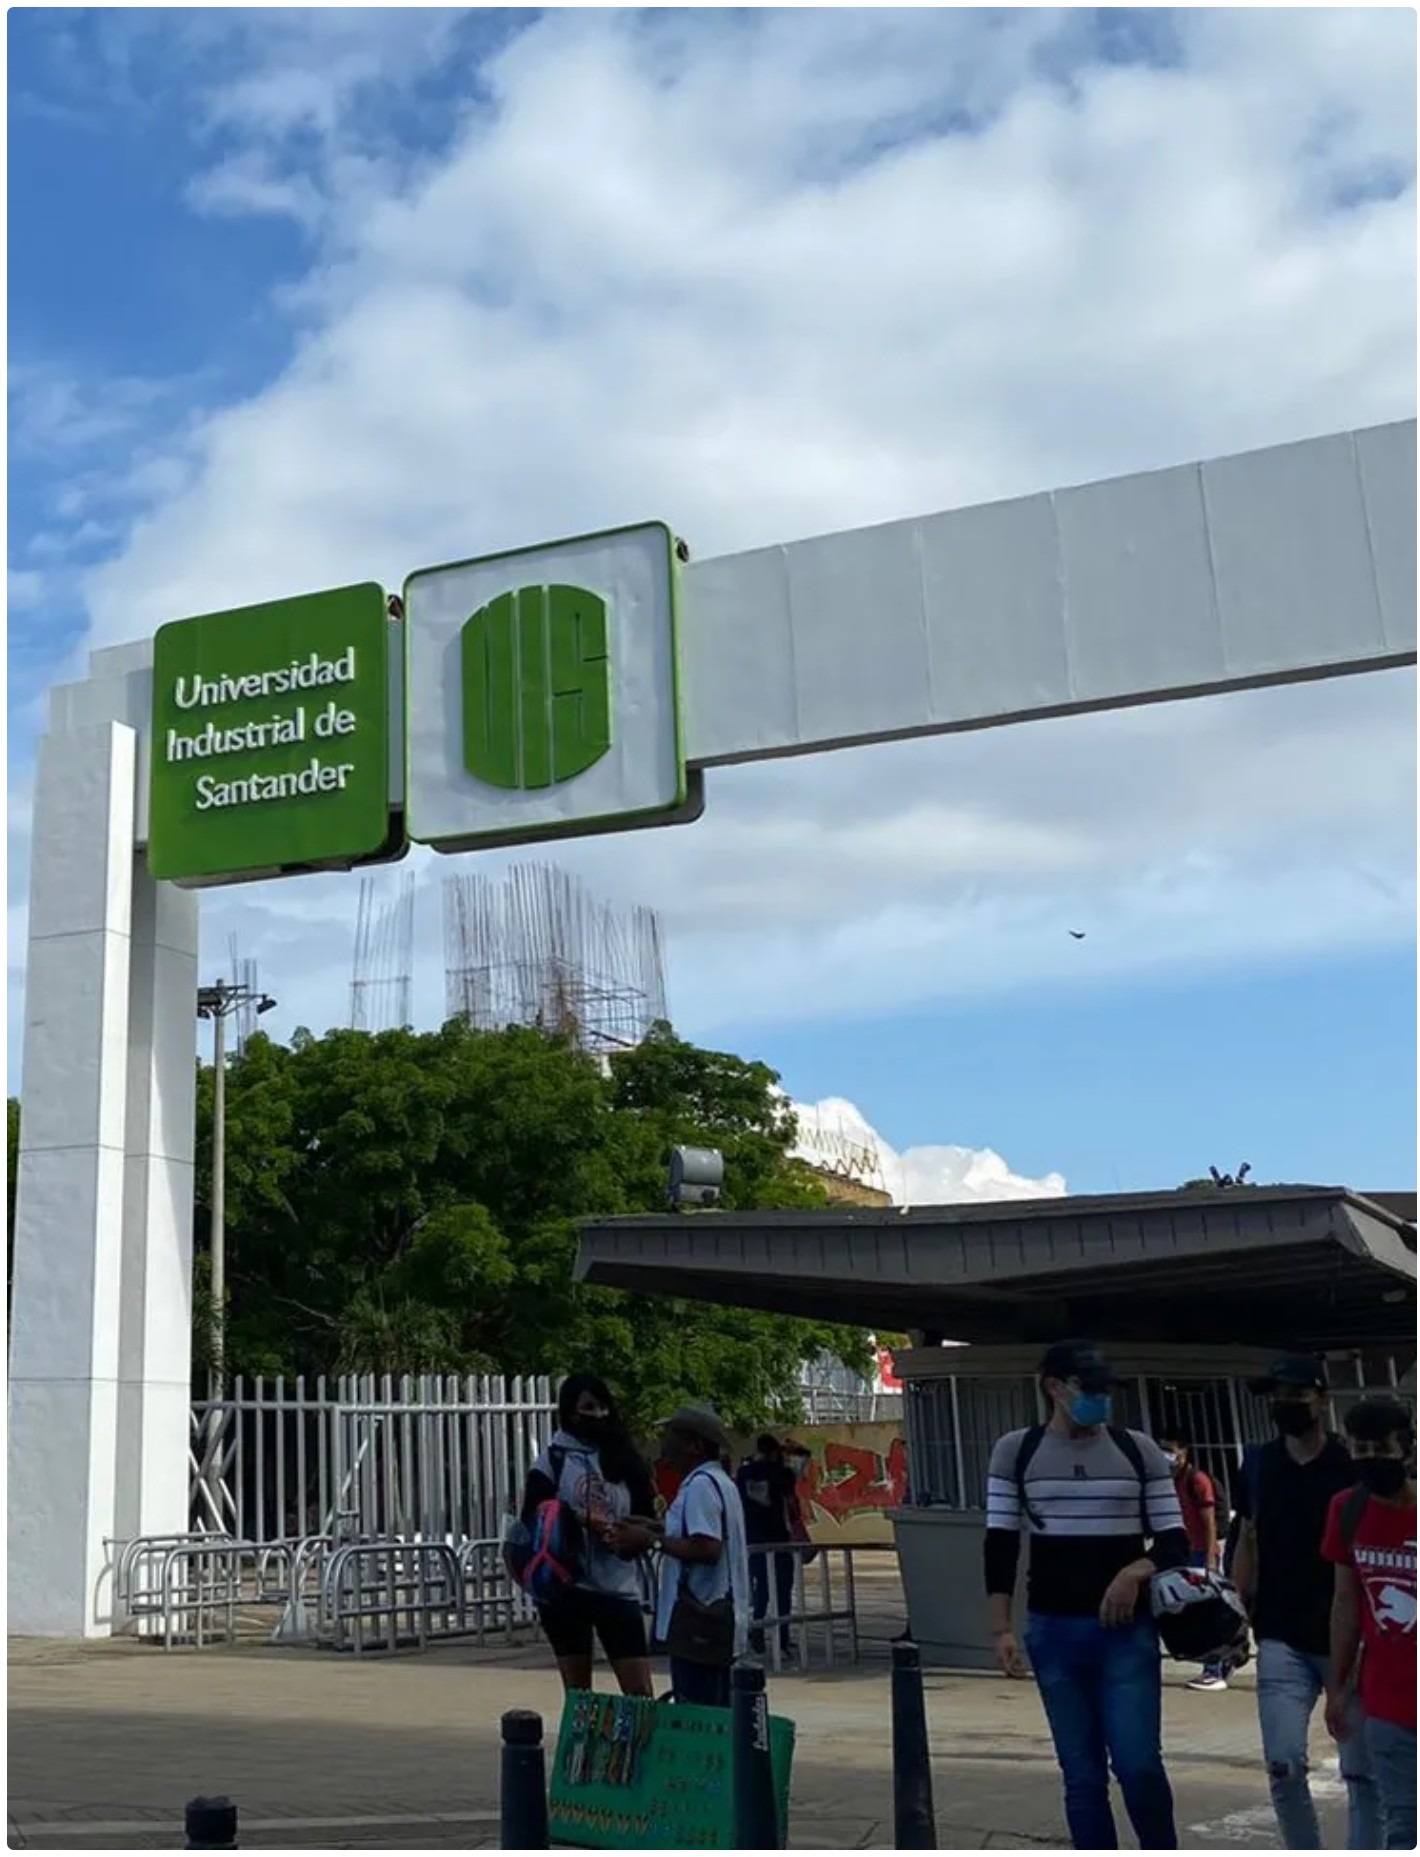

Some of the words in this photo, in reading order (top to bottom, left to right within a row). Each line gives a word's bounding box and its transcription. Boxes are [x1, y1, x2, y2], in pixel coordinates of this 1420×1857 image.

[175, 645, 355, 708] Universidad
[167, 705, 305, 762] Industrial
[314, 701, 356, 736] de
[195, 757, 354, 809] Santander
